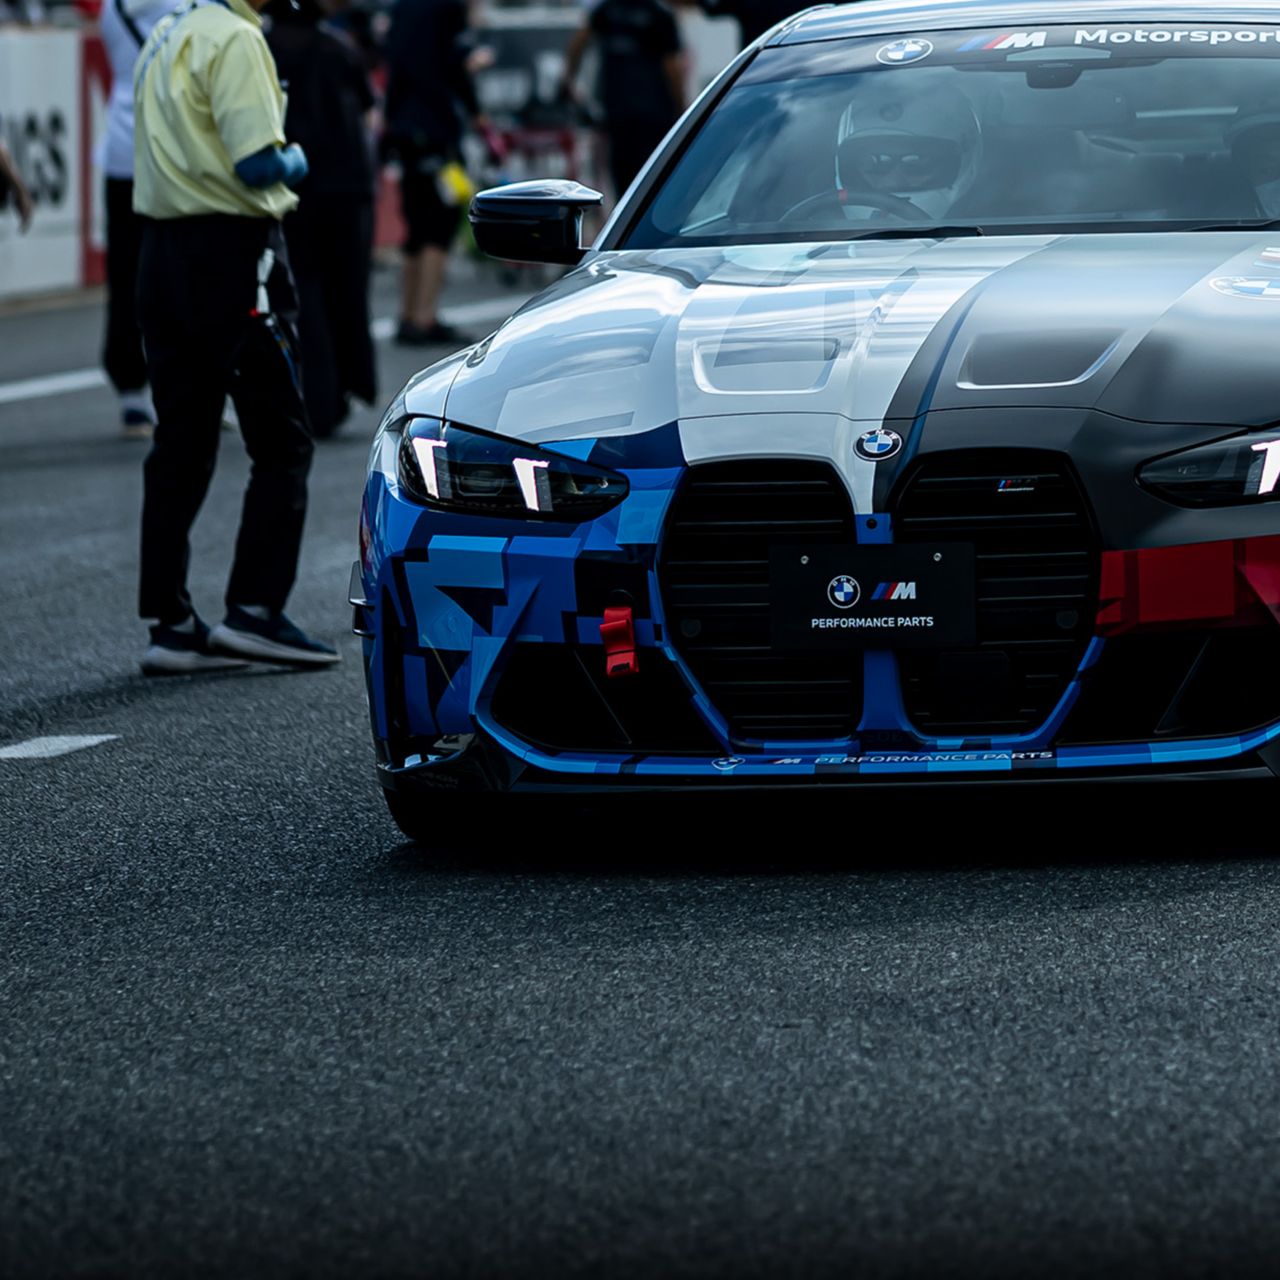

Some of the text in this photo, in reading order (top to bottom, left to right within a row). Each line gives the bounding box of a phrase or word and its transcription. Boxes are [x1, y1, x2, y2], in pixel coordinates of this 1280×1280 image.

[811, 616, 934, 629] PERFORMANCE PARTS
[815, 753, 977, 764] PERFORMANCE
[982, 751, 1053, 761] PARTS
